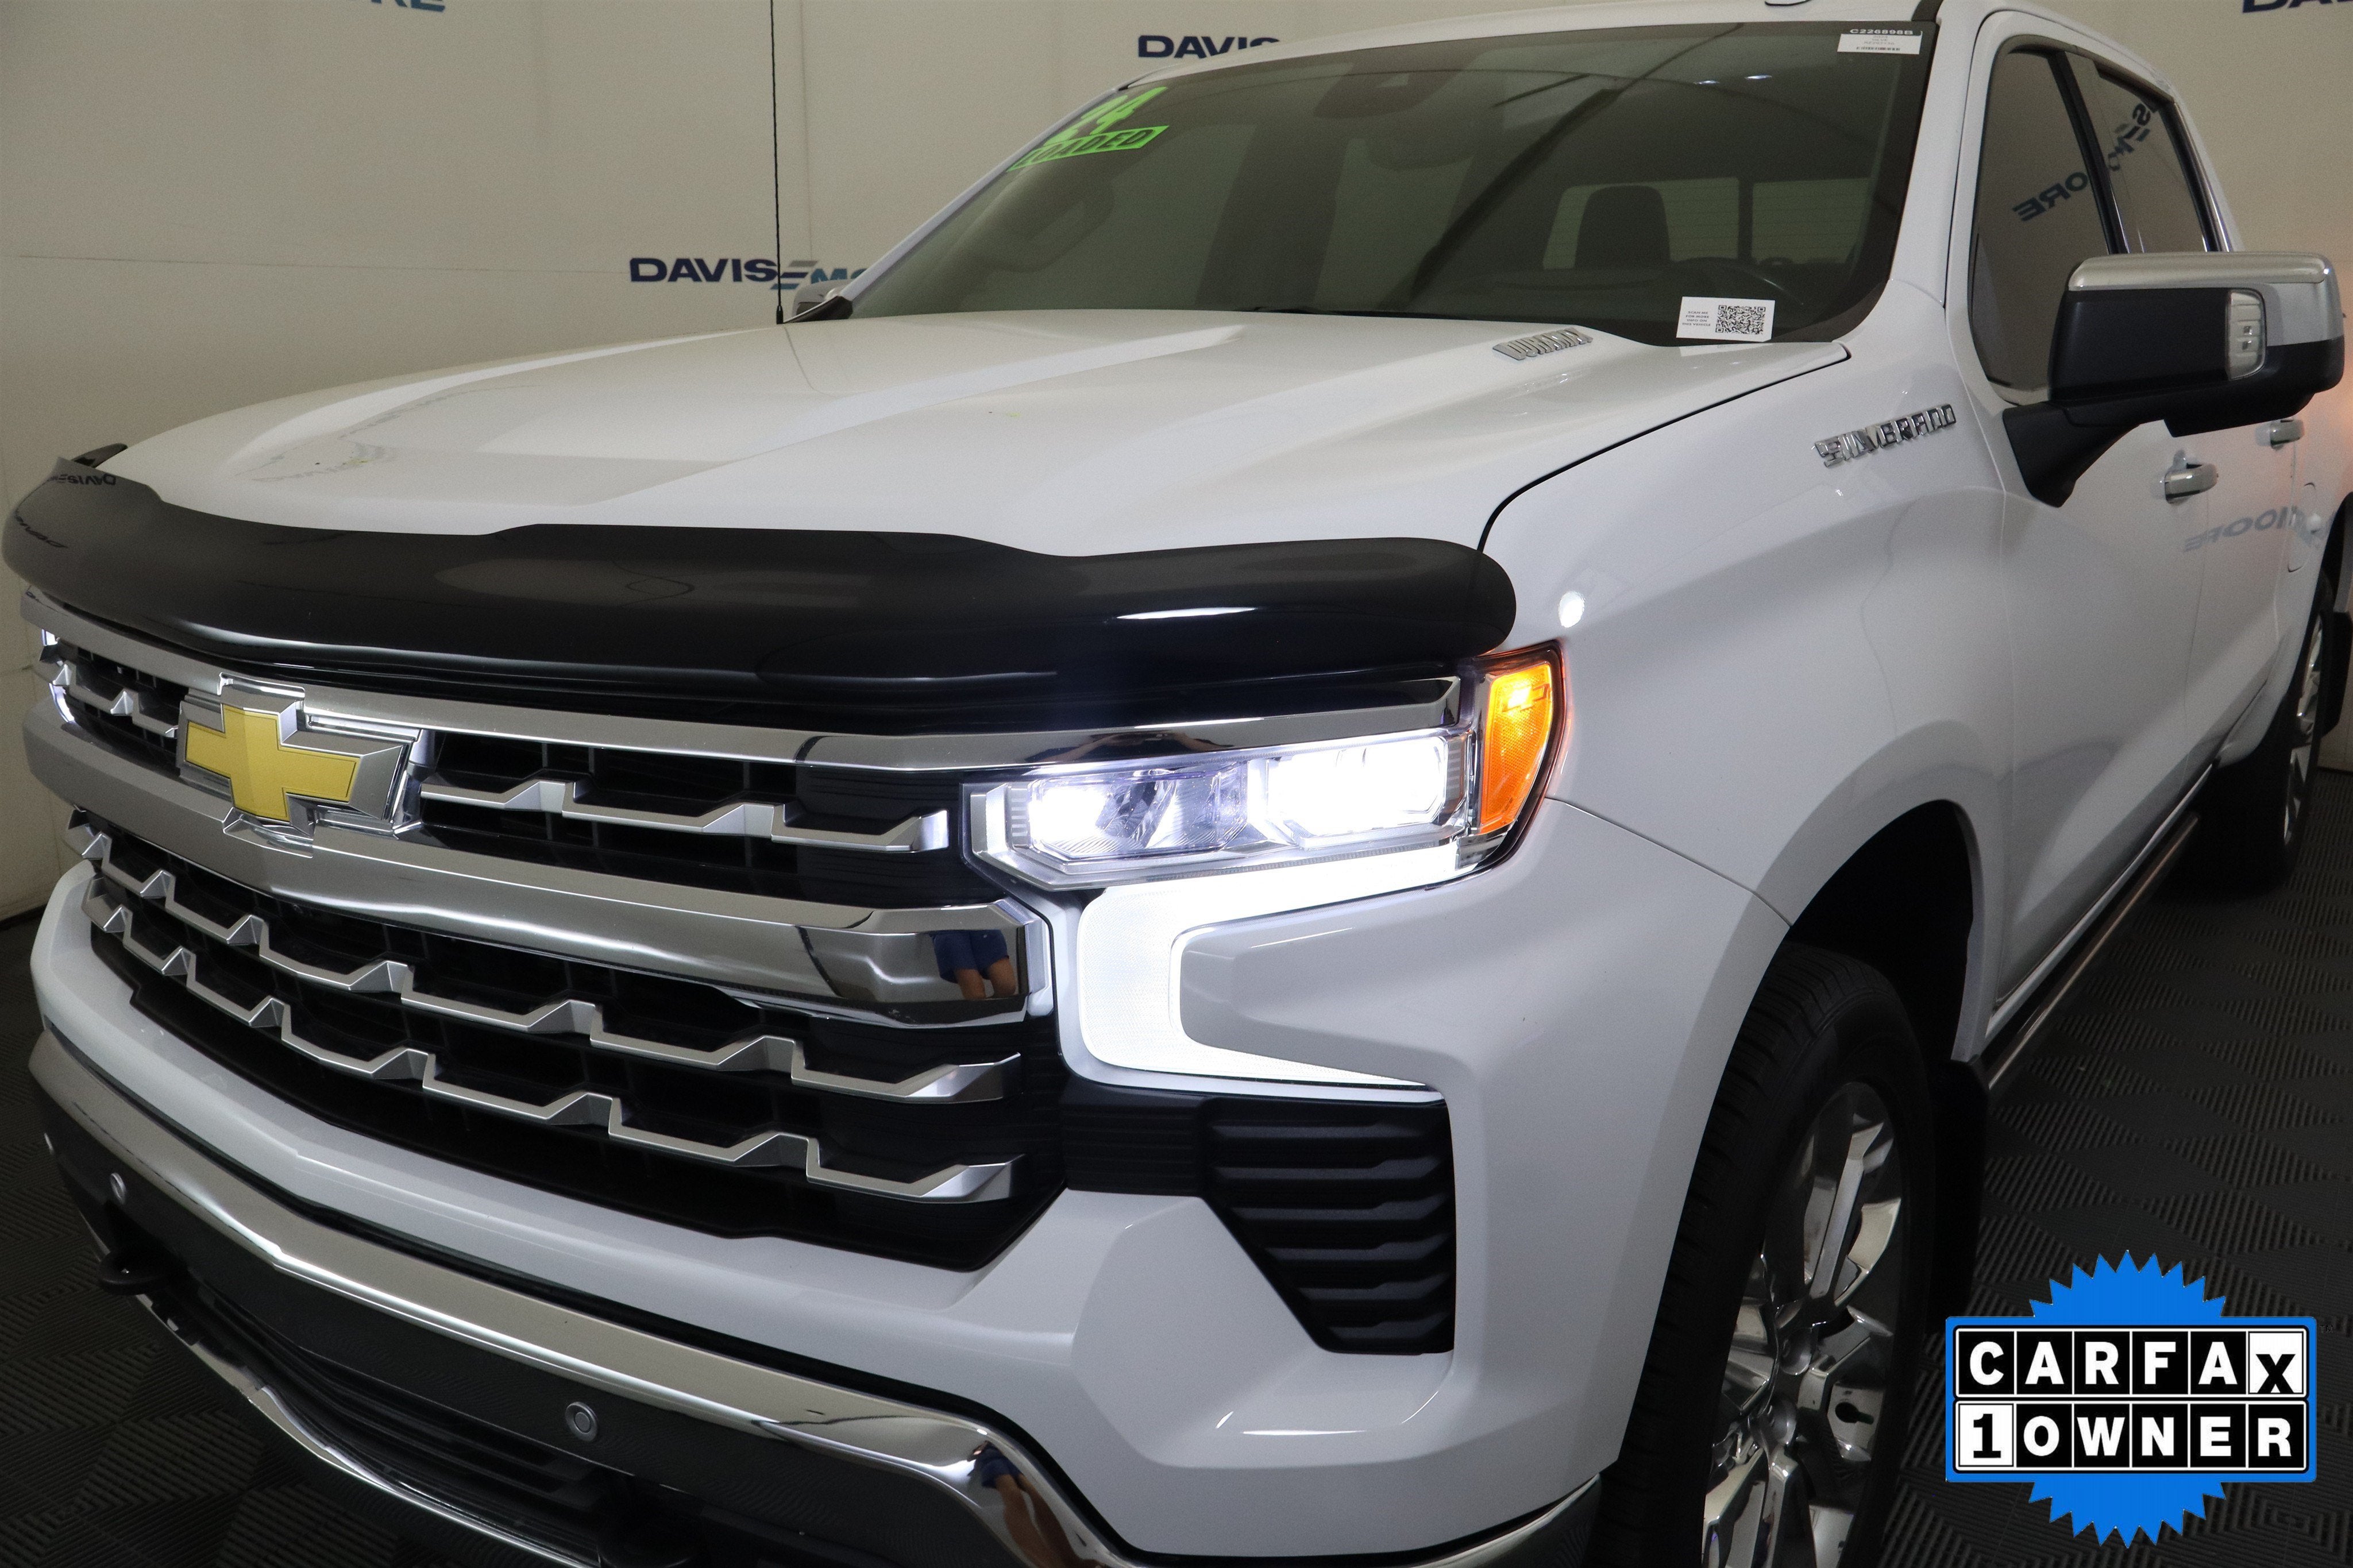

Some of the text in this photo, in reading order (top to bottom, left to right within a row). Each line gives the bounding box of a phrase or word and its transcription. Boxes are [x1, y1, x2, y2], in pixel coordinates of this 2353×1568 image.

[630, 257, 778, 282] DAVIS
[1492, 327, 1594, 361] DURAMAX
[1814, 404, 1957, 468] SILVERADO
